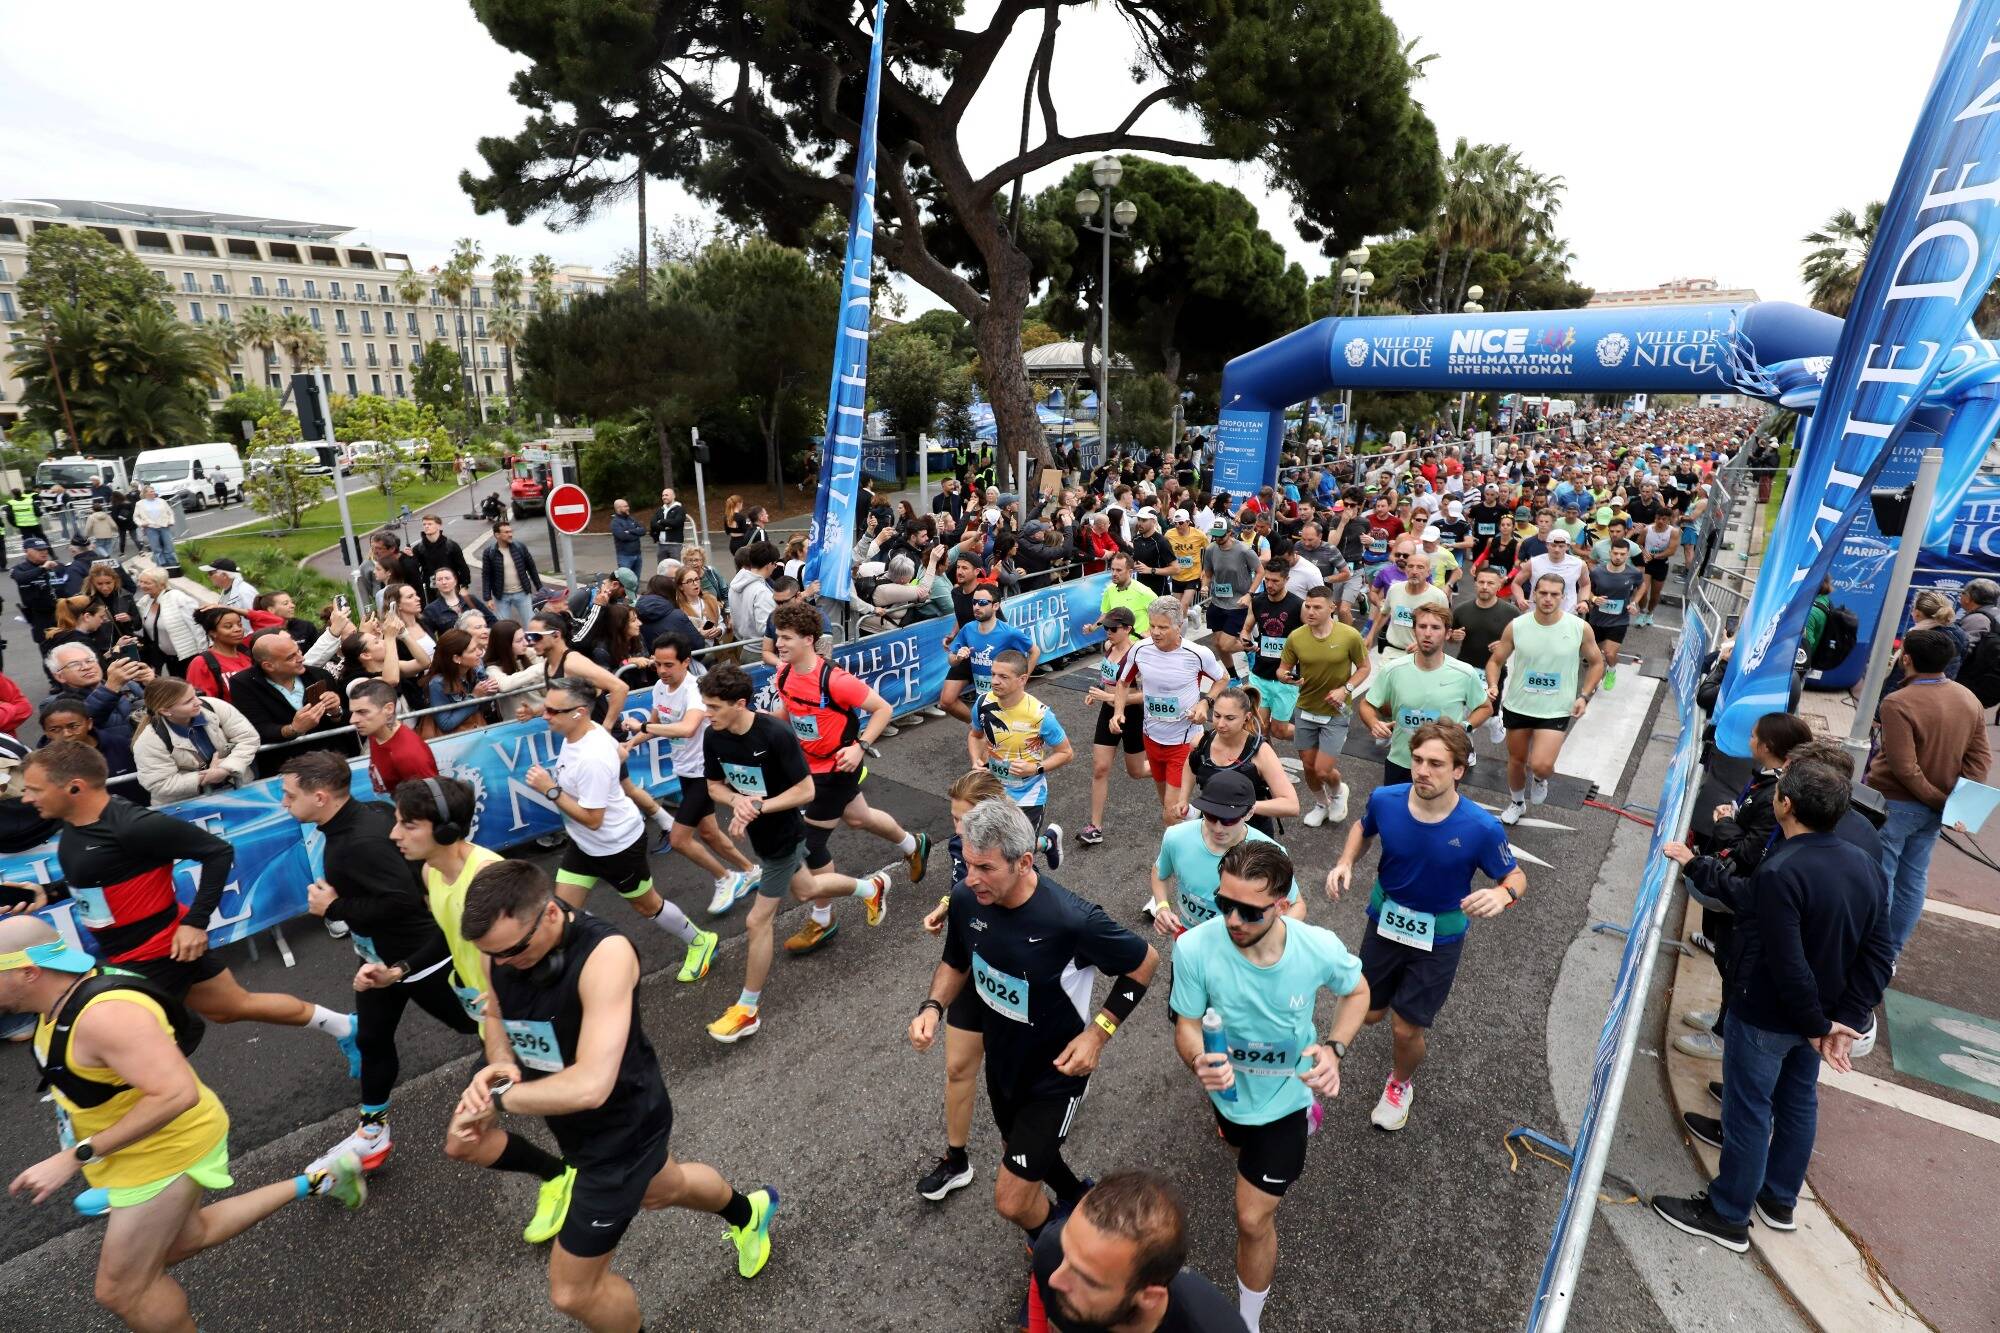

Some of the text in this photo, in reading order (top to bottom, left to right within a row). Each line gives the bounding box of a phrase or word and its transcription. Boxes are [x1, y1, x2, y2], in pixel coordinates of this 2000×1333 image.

[1373, 336, 1434, 348] VILLE DE
[1450, 328, 1529, 354] NICE
[1636, 329, 1720, 344] VILLE DE
[1372, 349, 1431, 367] NICE
[1632, 343, 1715, 367] NICE
[1448, 365, 1572, 375] INTERNATIONAL
[863, 456, 886, 472] CE
[1047, 593, 1069, 617] DE
[1397, 611, 1414, 620] 653
[1020, 614, 1071, 654] ICE
[1264, 642, 1283, 651] 4103
[832, 636, 920, 677] ILLE DE
[974, 651, 990, 660] NICE
[1528, 676, 1556, 687] 8833
[1148, 702, 1176, 713] 8886
[490, 731, 560, 773] VIL
[991, 763, 1009, 777] 869
[728, 772, 758, 786] 9124
[1181, 894, 1217, 919] 9073
[1385, 911, 1428, 935] 5363
[977, 970, 1020, 1006] 9026
[1233, 1049, 1286, 1064] 8941
